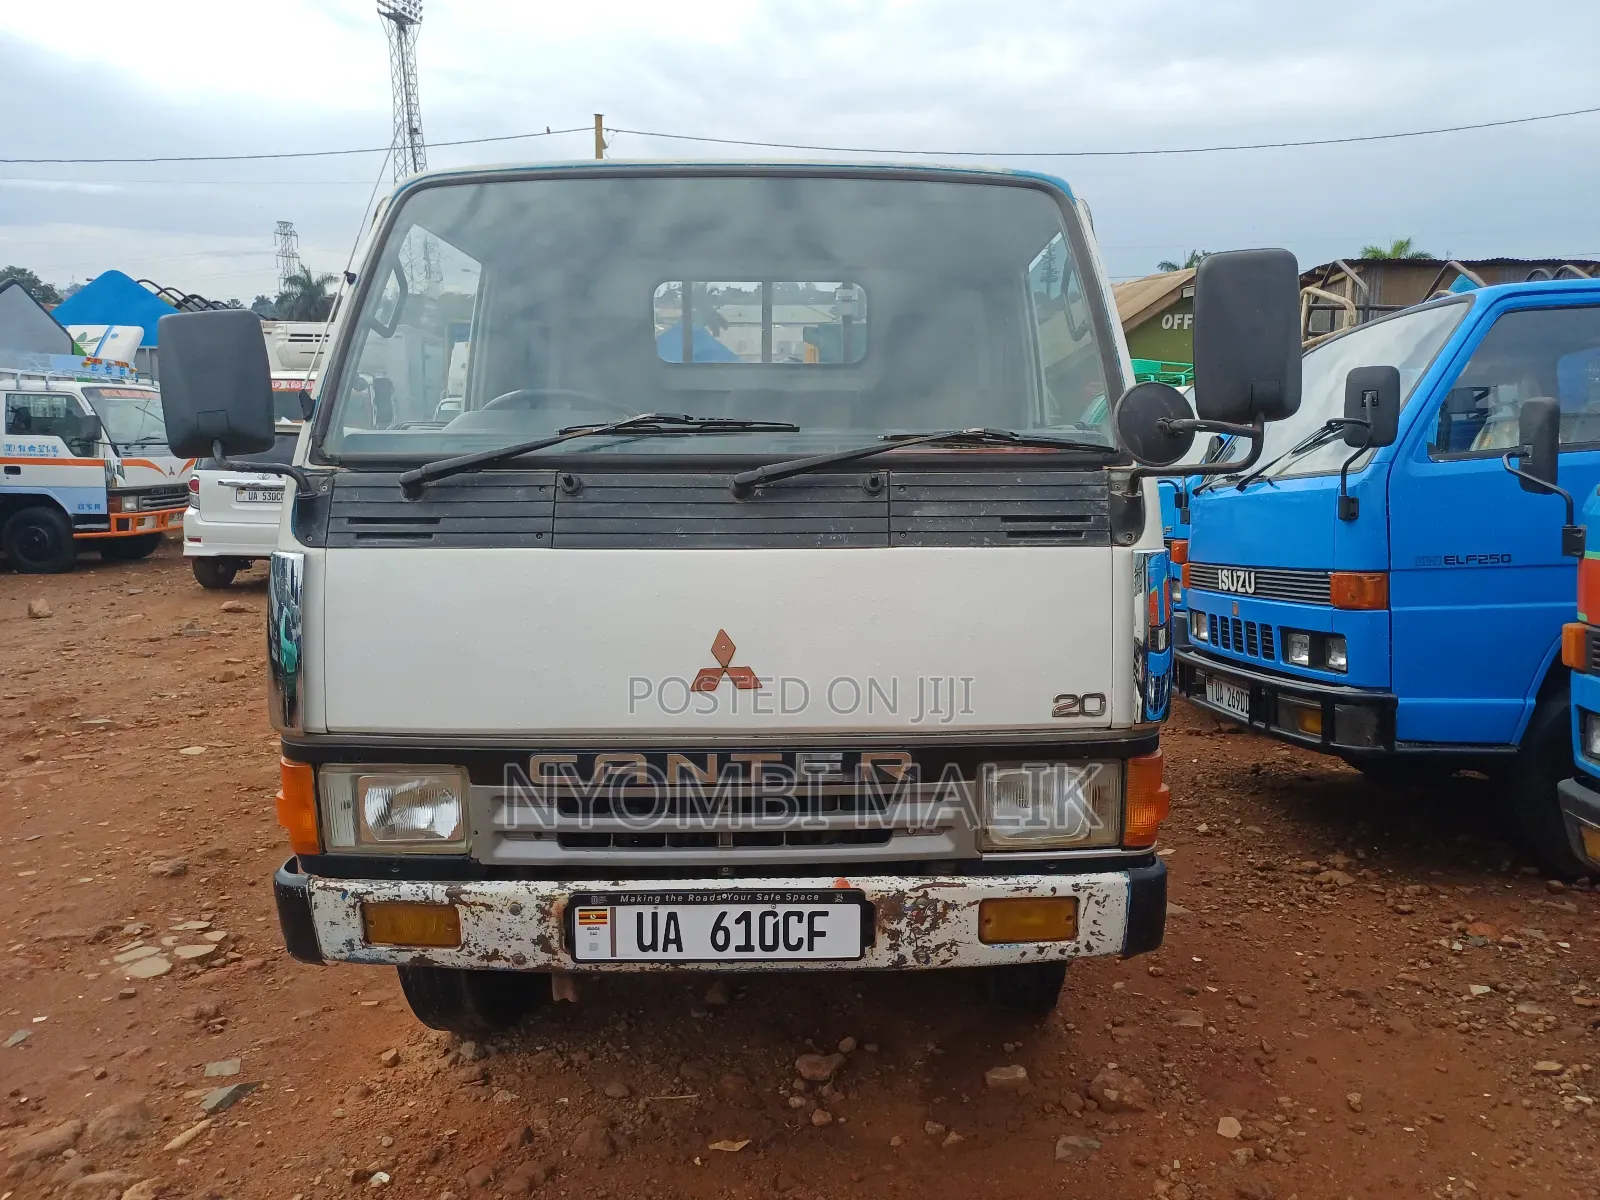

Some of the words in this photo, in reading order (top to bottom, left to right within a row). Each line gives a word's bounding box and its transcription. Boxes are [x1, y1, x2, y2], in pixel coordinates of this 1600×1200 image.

[1161, 314, 1194, 330] OFF
[248, 491, 258, 501] UA
[1443, 553, 1512, 566] ELF250
[1217, 569, 1256, 594] ISUZU
[1052, 692, 1107, 718] 20
[1215, 682, 1224, 705] UA
[529, 752, 915, 784] CANTER
[620, 894, 661, 904] Making
[665, 893, 683, 902] the
[687, 893, 722, 902] Roads
[727, 892, 752, 901] Your
[756, 893, 781, 901] Safe
[785, 893, 820, 903] Space
[636, 911, 684, 953] UA
[709, 910, 830, 953] 610CF
